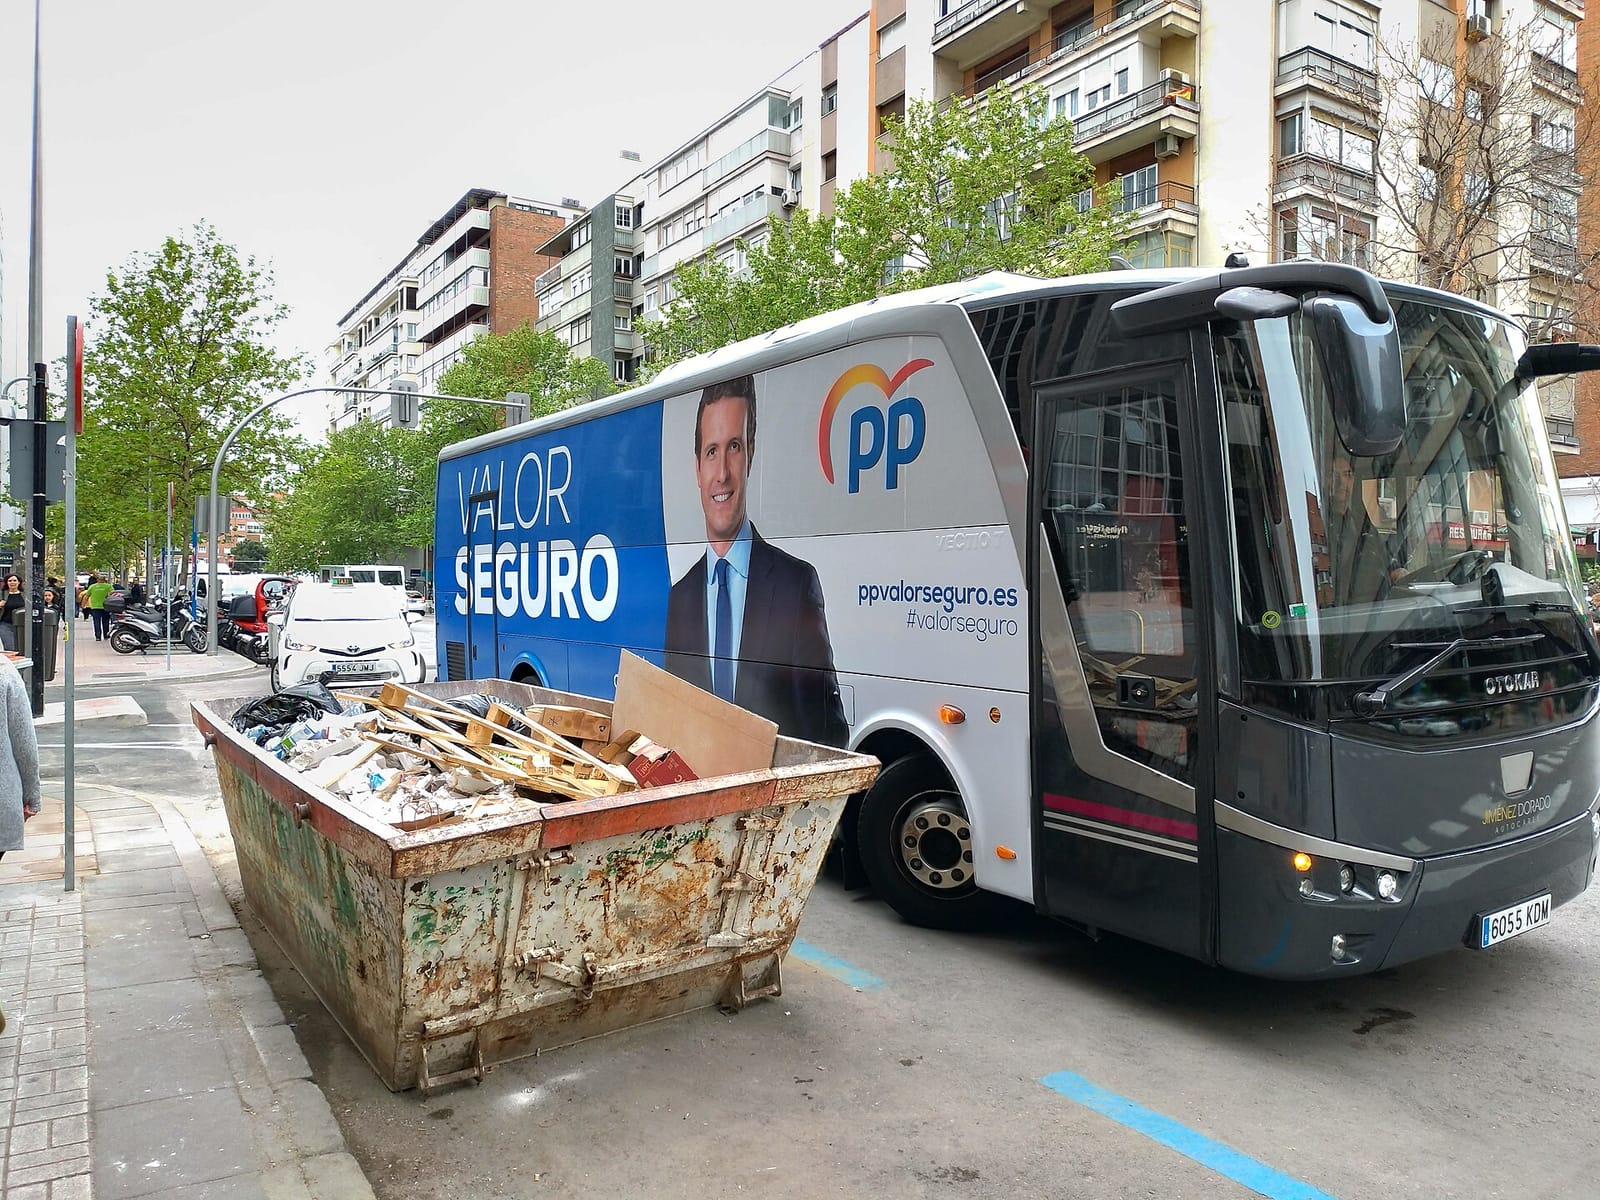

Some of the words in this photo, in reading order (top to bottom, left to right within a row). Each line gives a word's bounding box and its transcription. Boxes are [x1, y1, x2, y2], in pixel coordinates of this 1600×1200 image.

[457, 445, 573, 535] VALOR
[454, 533, 620, 622] SEGURO
[858, 580, 1018, 613] ppvalorseguro.es
[907, 609, 1018, 641] #valorseguro
[337, 664, 356, 672] 5554
[359, 664, 374, 672] JMJ
[1485, 671, 1539, 695] OTOKAR
[1517, 794, 1552, 817] DORADO
[1491, 909, 1522, 940] 6055
[1526, 898, 1549, 927] KDM
